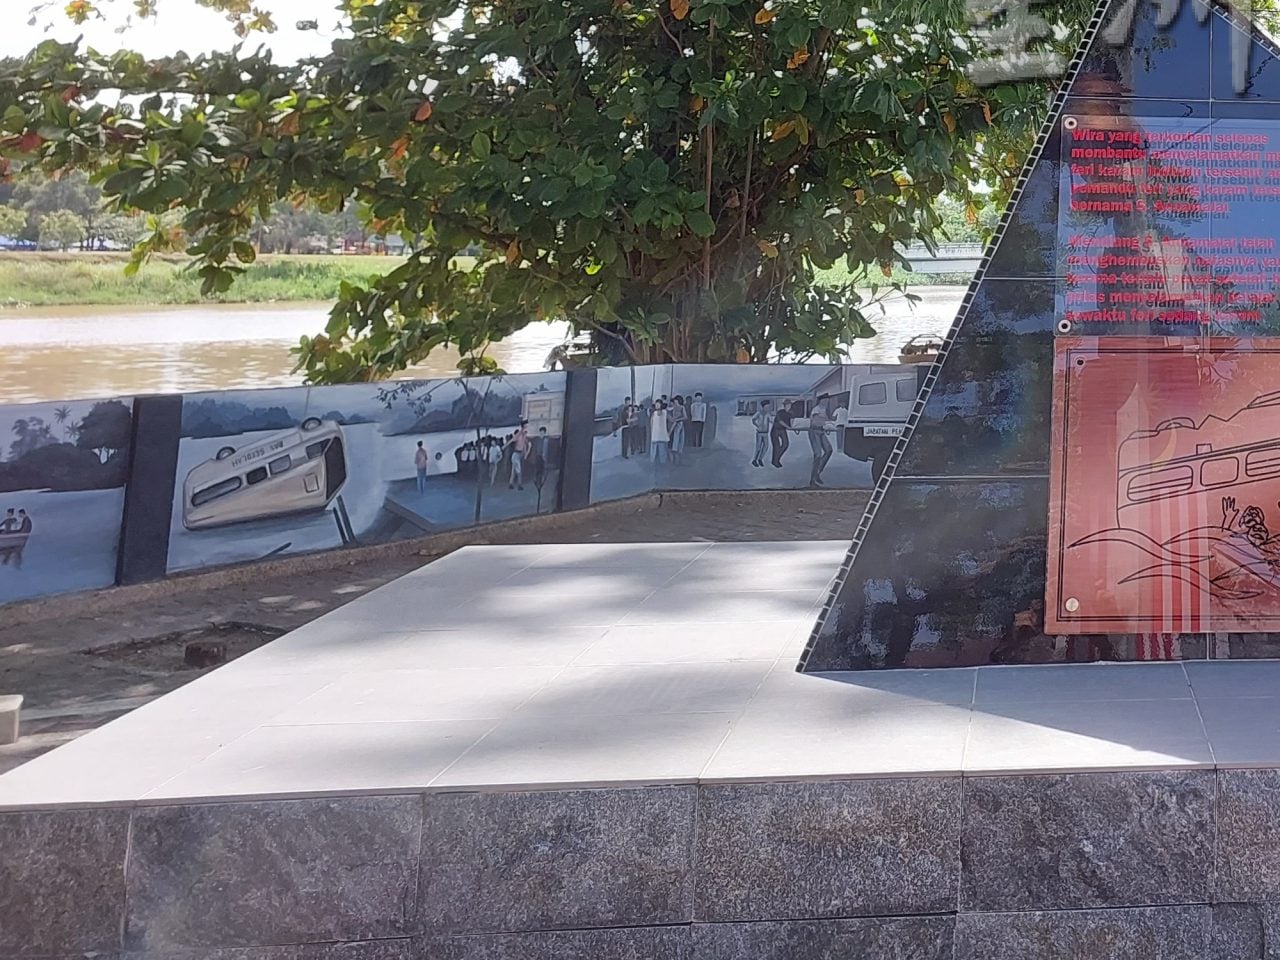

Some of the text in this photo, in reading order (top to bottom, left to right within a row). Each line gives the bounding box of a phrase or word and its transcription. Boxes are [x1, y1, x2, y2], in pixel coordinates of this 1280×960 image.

[1072, 129, 1269, 144] Wira yang terkorban selepas
[1205, 166, 1263, 178] tersebut
[1203, 185, 1248, 196] karam
